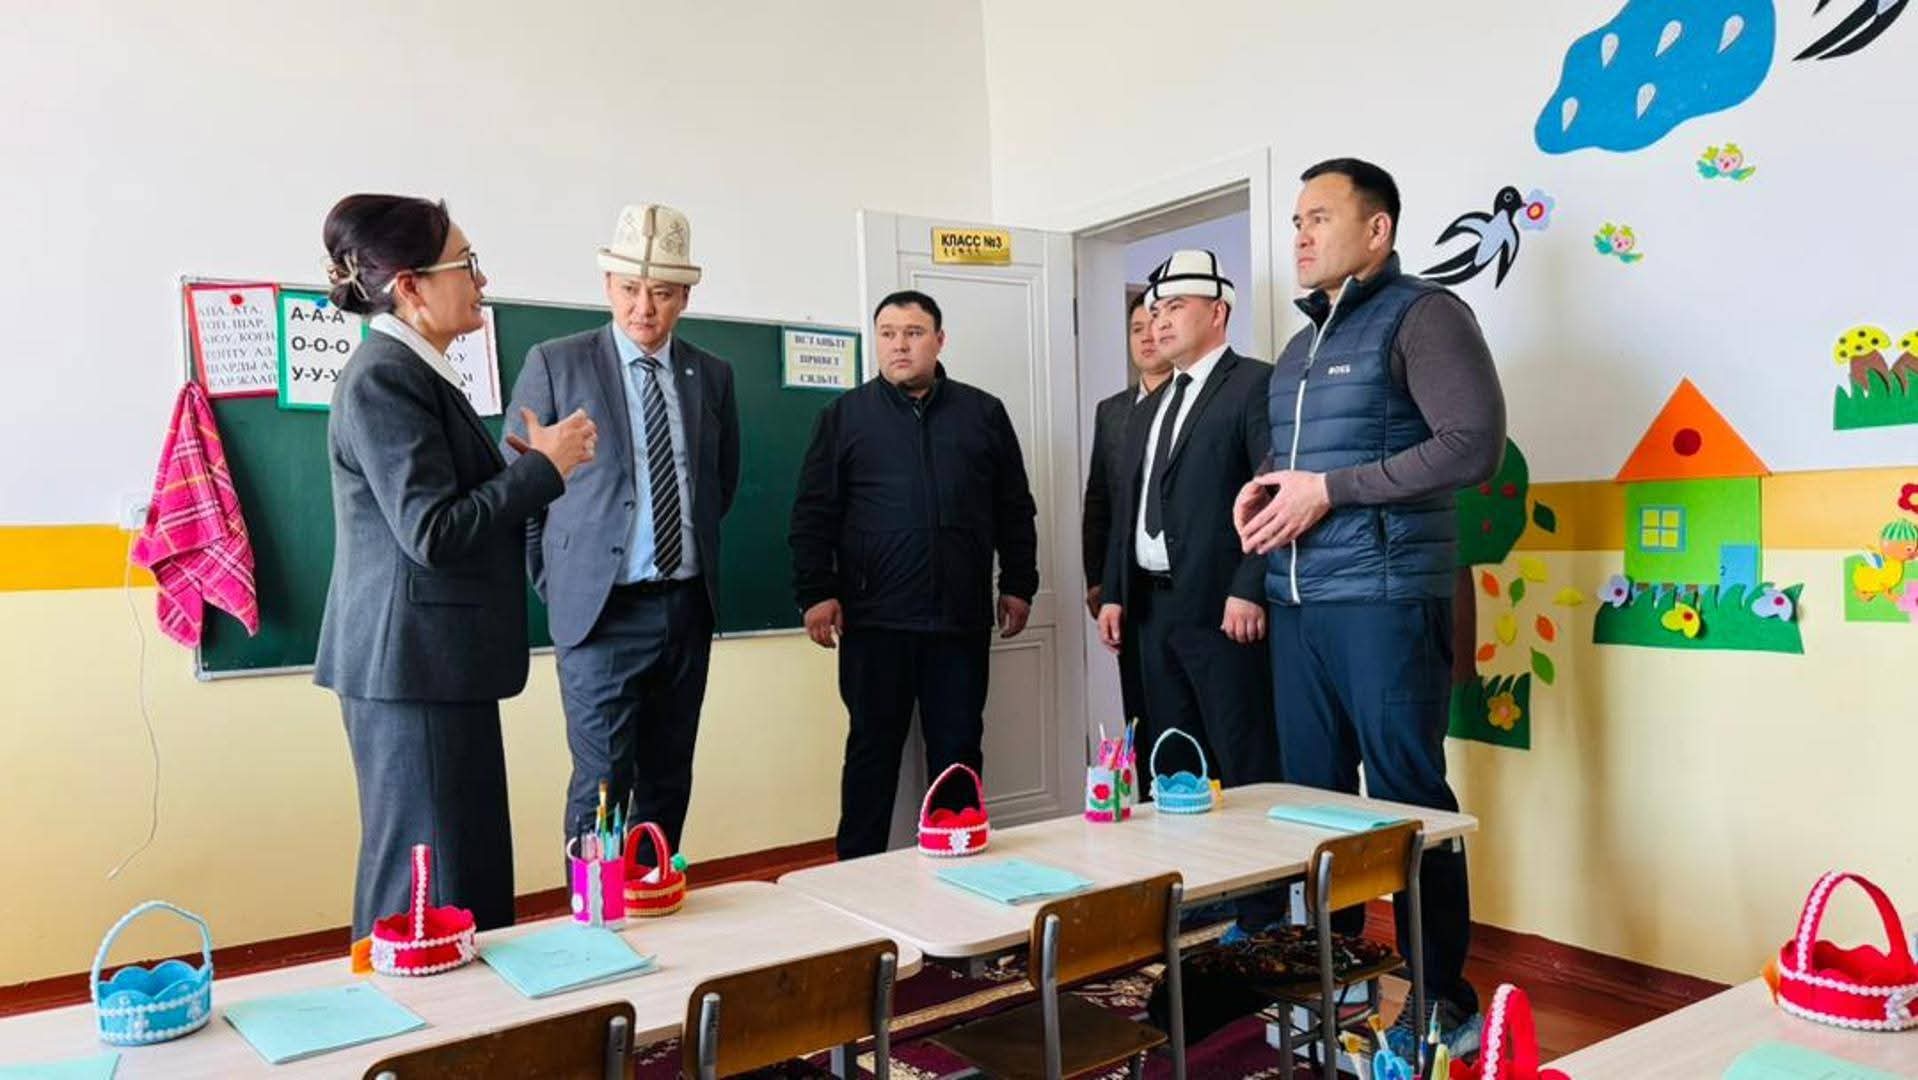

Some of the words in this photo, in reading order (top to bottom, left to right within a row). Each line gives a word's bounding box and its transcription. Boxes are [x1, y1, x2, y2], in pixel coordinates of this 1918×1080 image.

[941, 233, 981, 247] КЛАСС
[983, 234, 1003, 249] №3
[291, 306, 345, 324] А-А-А
[292, 336, 350, 354] О-О-О
